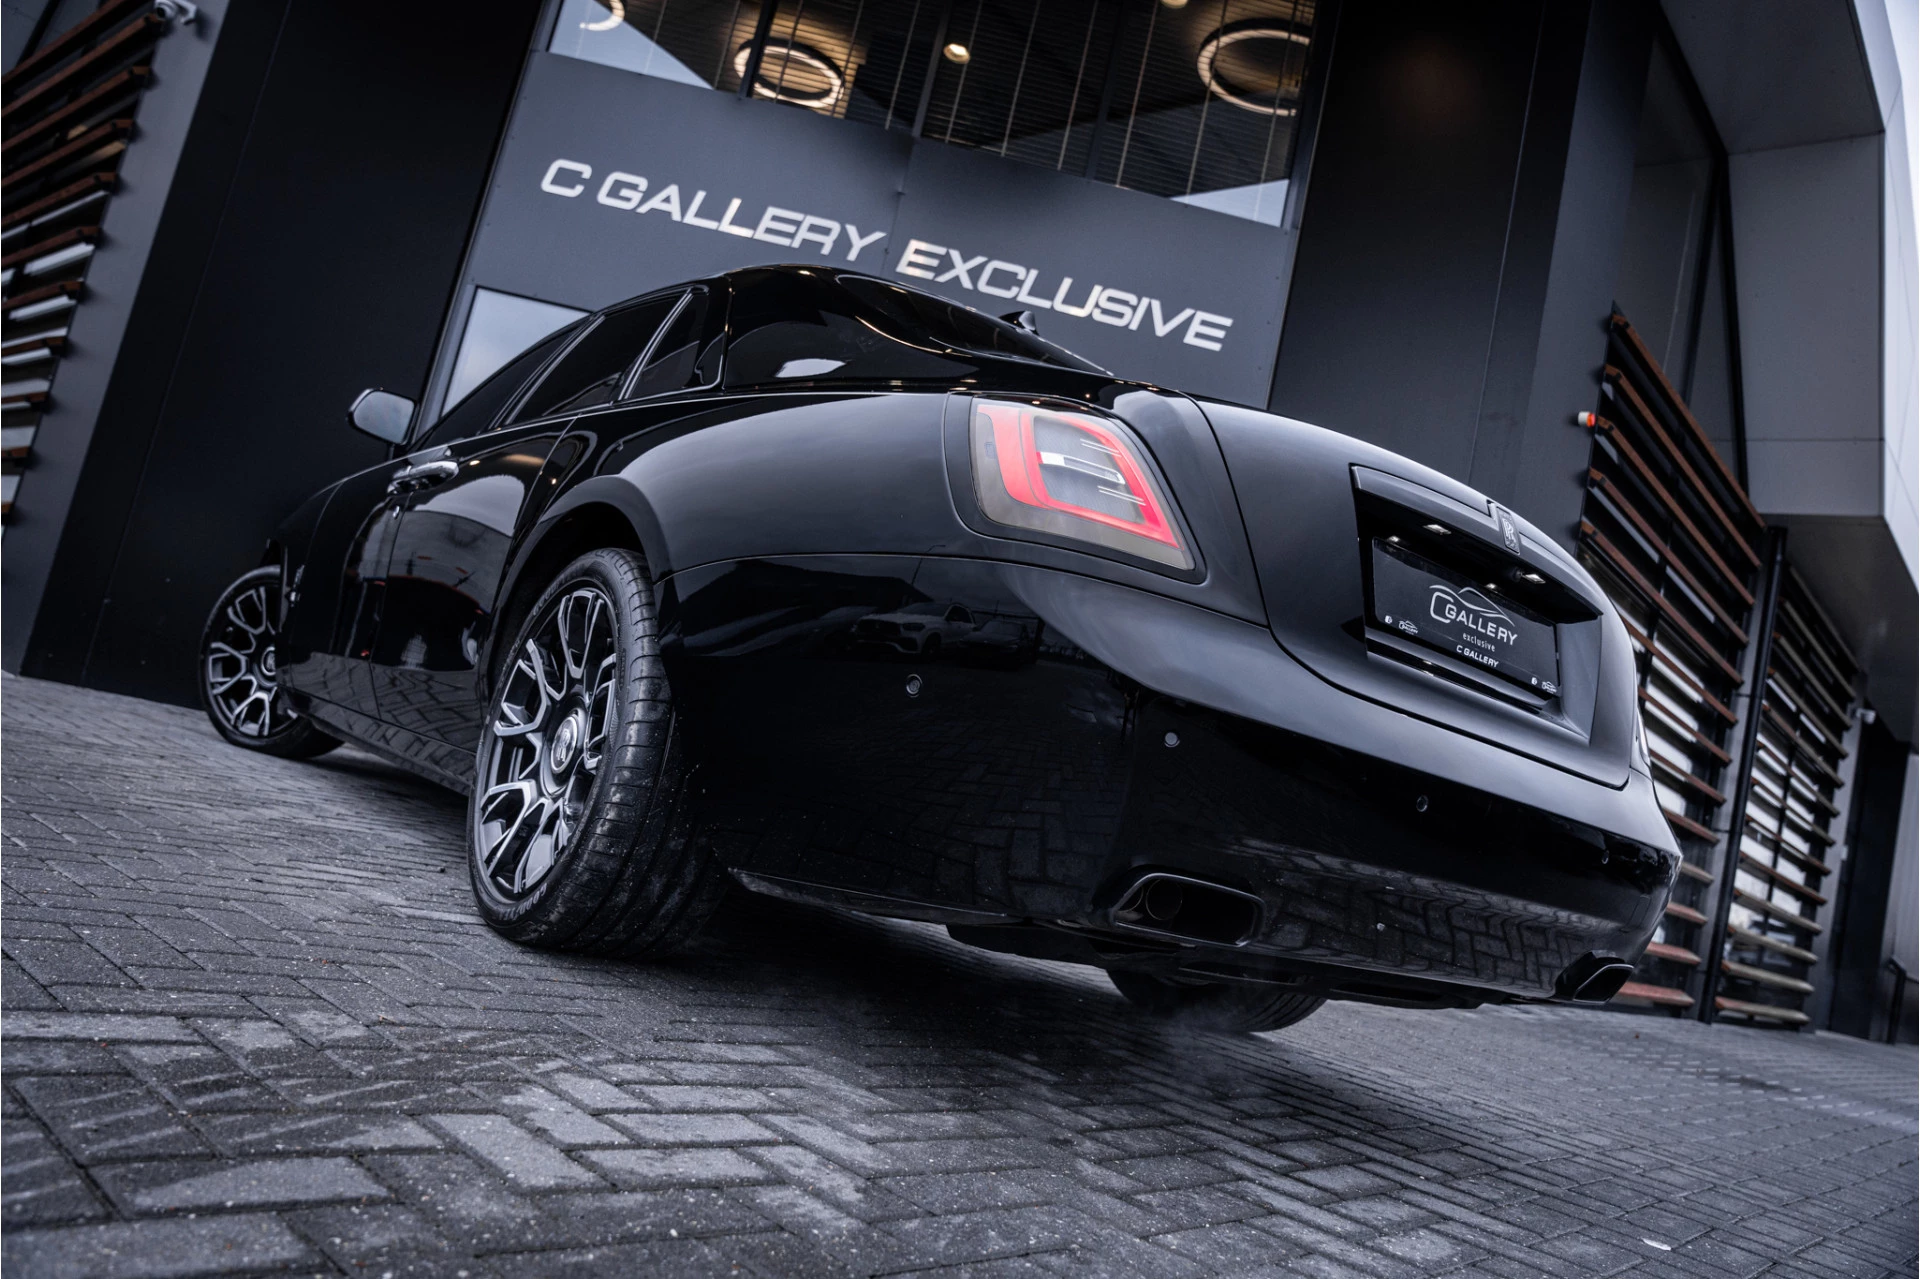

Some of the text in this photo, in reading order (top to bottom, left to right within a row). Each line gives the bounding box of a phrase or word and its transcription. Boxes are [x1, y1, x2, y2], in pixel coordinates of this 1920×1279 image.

[541, 158, 1234, 352] C GALLERY EXCLUSIVE
[1462, 632, 1496, 652] exclusive
[1456, 644, 1500, 668] C GALLERY
